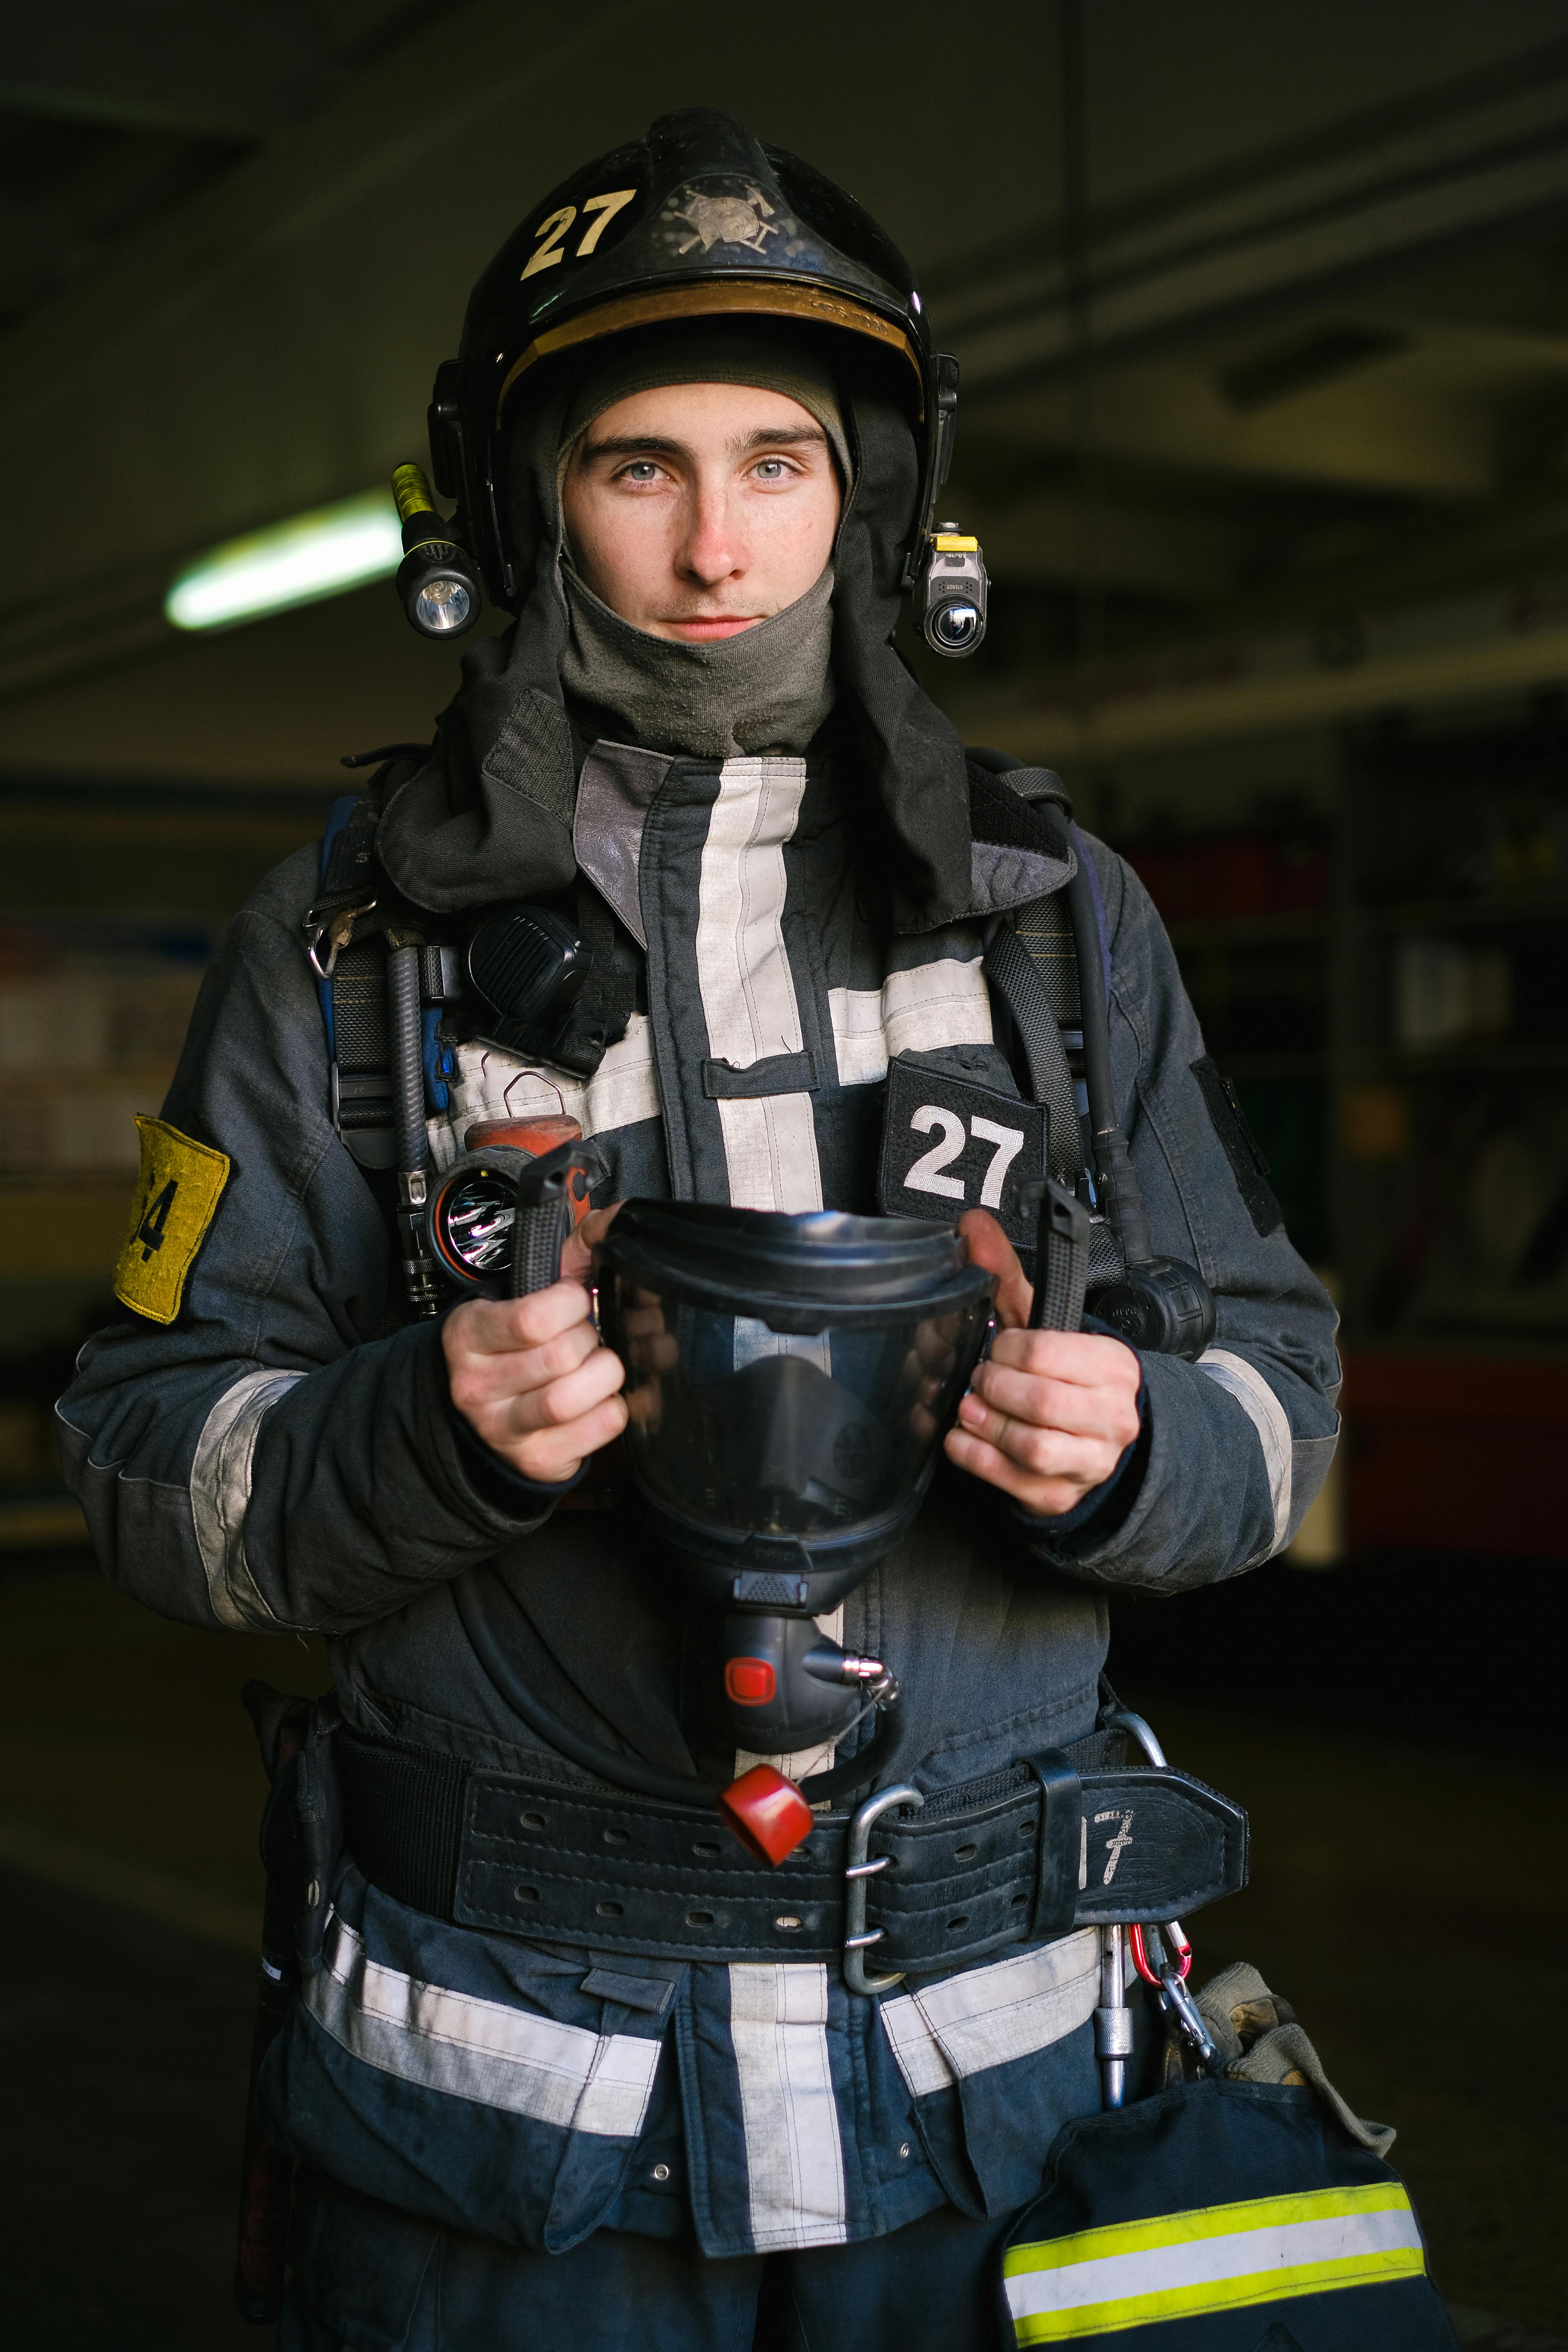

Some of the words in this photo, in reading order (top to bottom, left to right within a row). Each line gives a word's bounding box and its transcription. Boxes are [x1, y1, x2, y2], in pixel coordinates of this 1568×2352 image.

[520, 189, 637, 281] 27
[903, 1105, 1024, 1209] 27
[1078, 1809, 1135, 1890] 17
